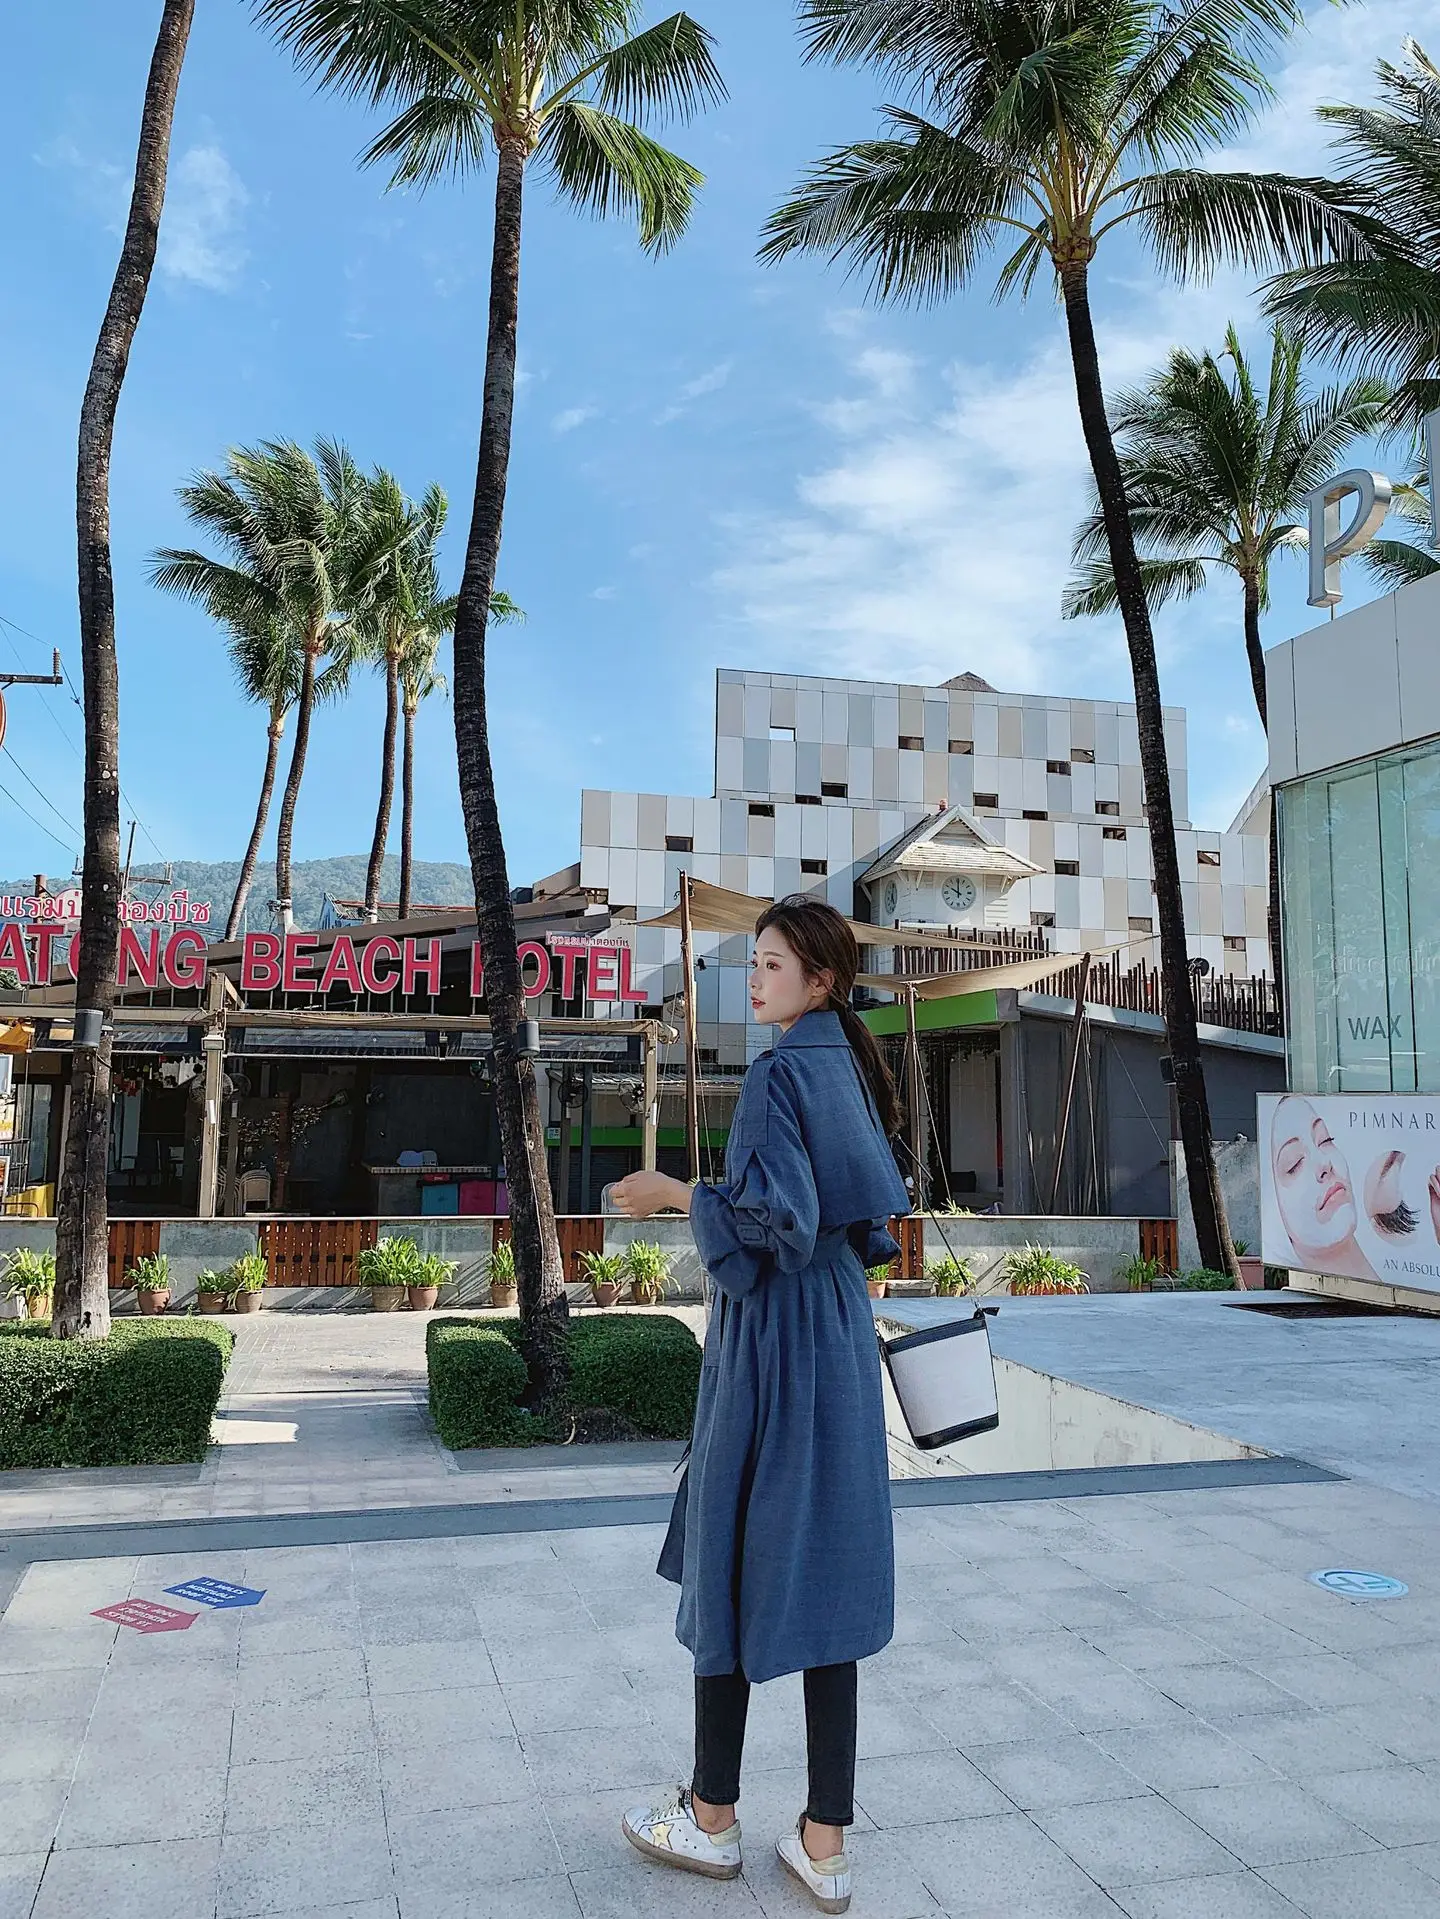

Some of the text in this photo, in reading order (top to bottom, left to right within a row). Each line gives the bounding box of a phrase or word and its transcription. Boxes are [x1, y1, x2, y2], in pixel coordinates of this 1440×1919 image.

[0, 923, 208, 989] ATNG
[240, 932, 440, 996] BEACH
[1347, 1014, 1402, 1040] WAX
[1349, 1111, 1437, 1130] PIMNAR
[1383, 1259, 1399, 1271] AN
